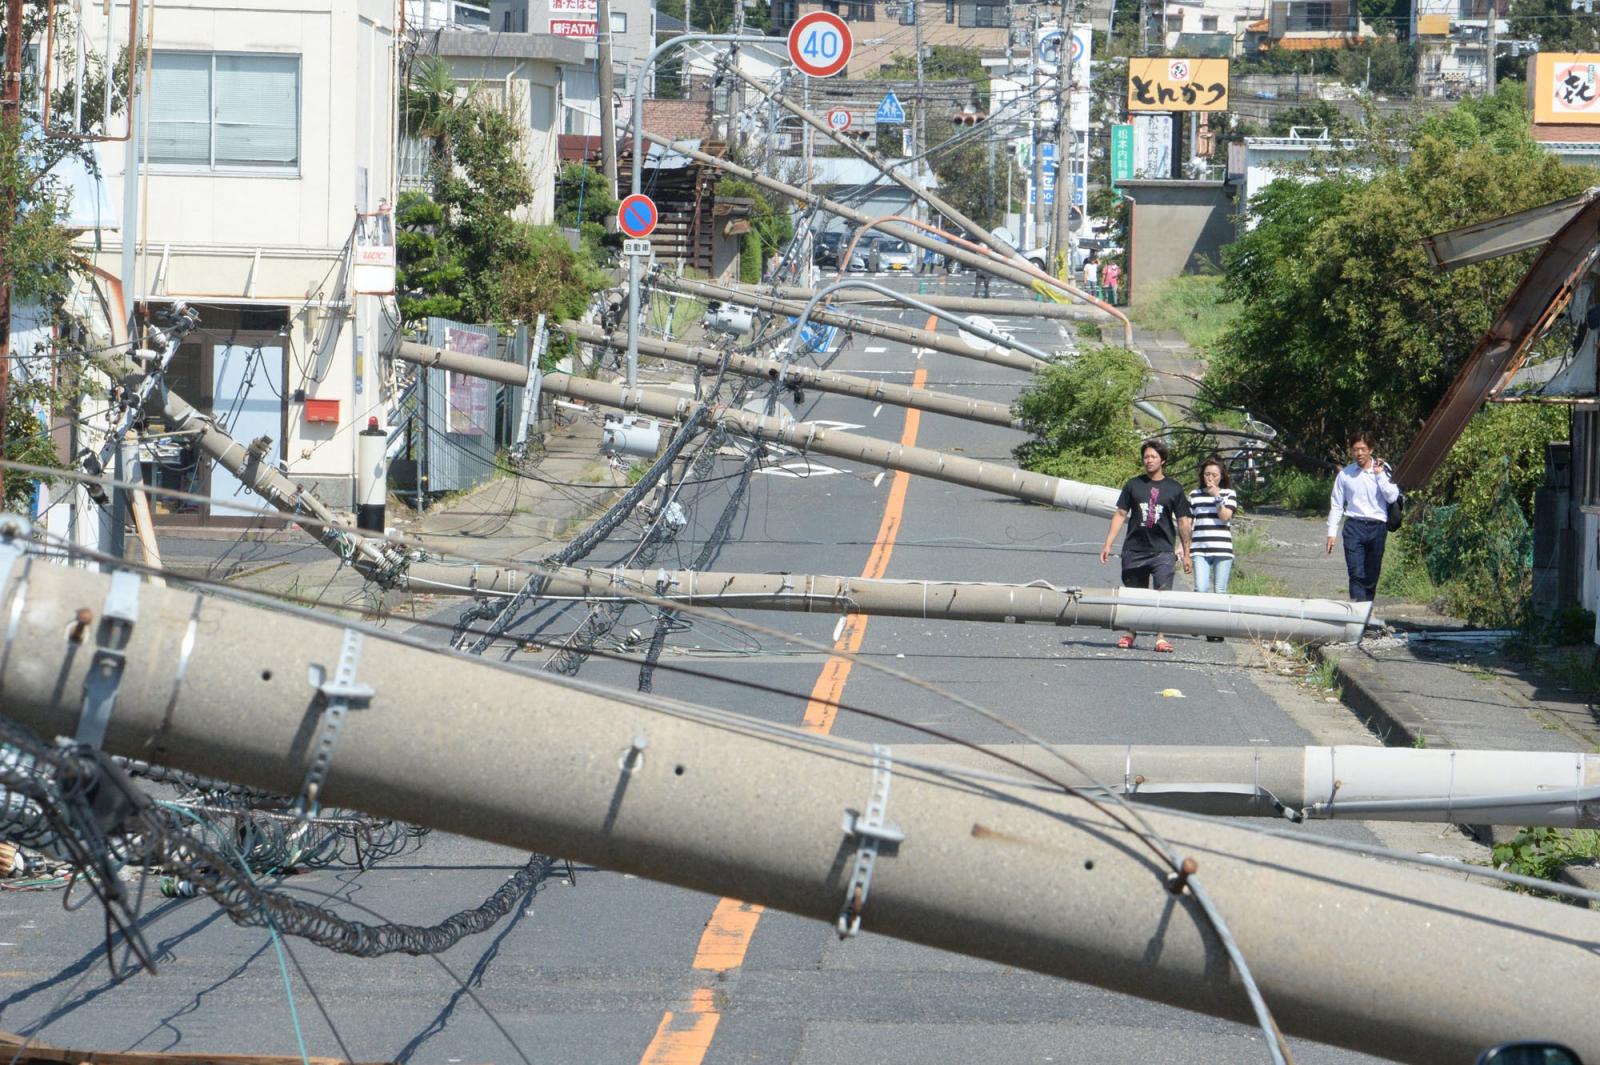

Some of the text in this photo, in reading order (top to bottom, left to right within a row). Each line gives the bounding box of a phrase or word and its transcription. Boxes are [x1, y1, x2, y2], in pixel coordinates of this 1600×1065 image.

[803, 30, 838, 59] 40
[1131, 75, 1226, 106] とんかつ
[832, 113, 846, 125] 40
[625, 243, 649, 251] 自動車
